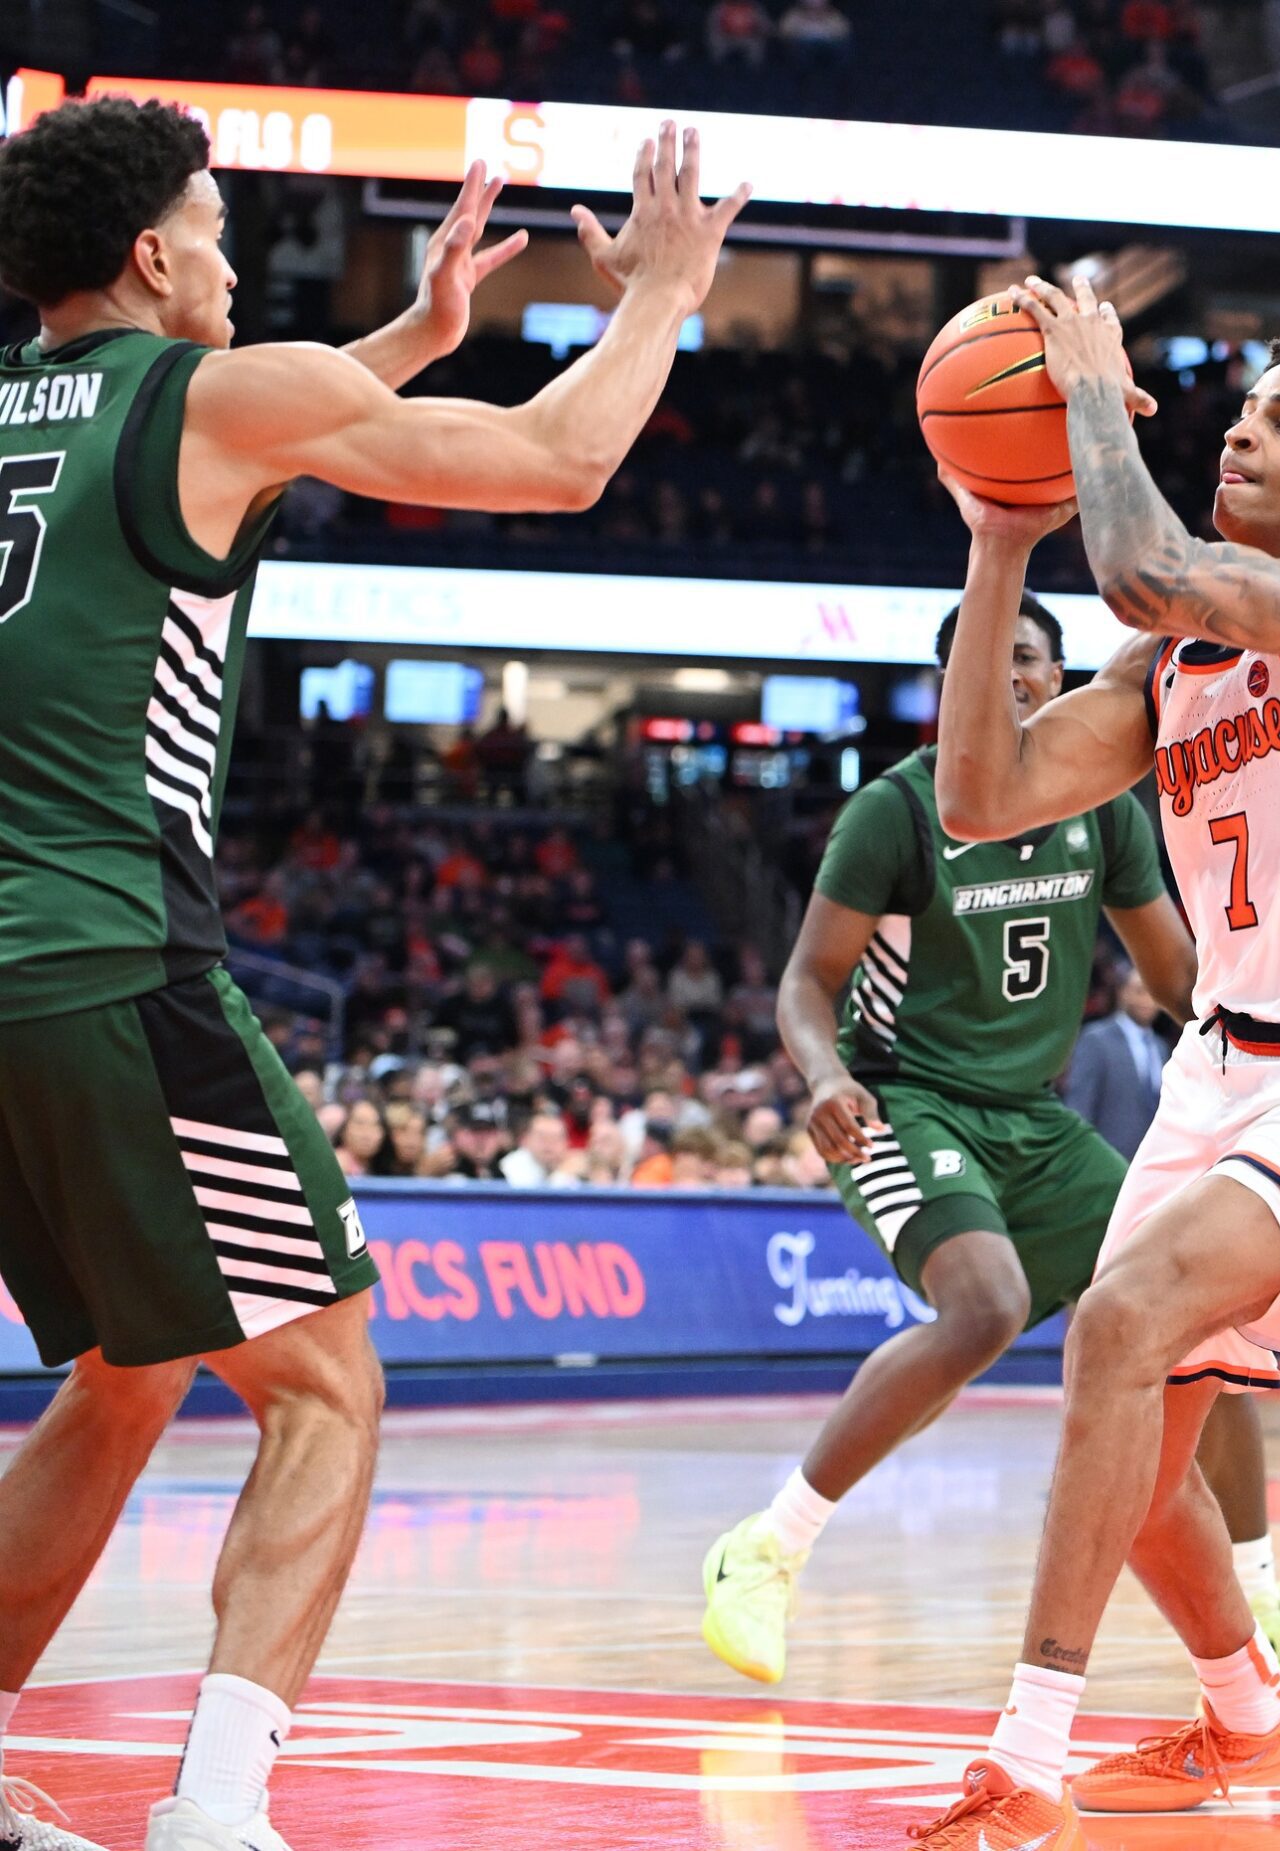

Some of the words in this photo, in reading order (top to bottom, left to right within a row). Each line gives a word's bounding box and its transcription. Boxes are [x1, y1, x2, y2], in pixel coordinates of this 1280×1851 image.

[956, 874, 1090, 911] BINGHAMTON
[1208, 811, 1258, 931] 7
[1002, 916, 1050, 1002] 5
[930, 1148, 966, 1180] B
[367, 1239, 480, 1321] ICS
[479, 1241, 646, 1319] FUND
[766, 1230, 906, 1328] Turning
